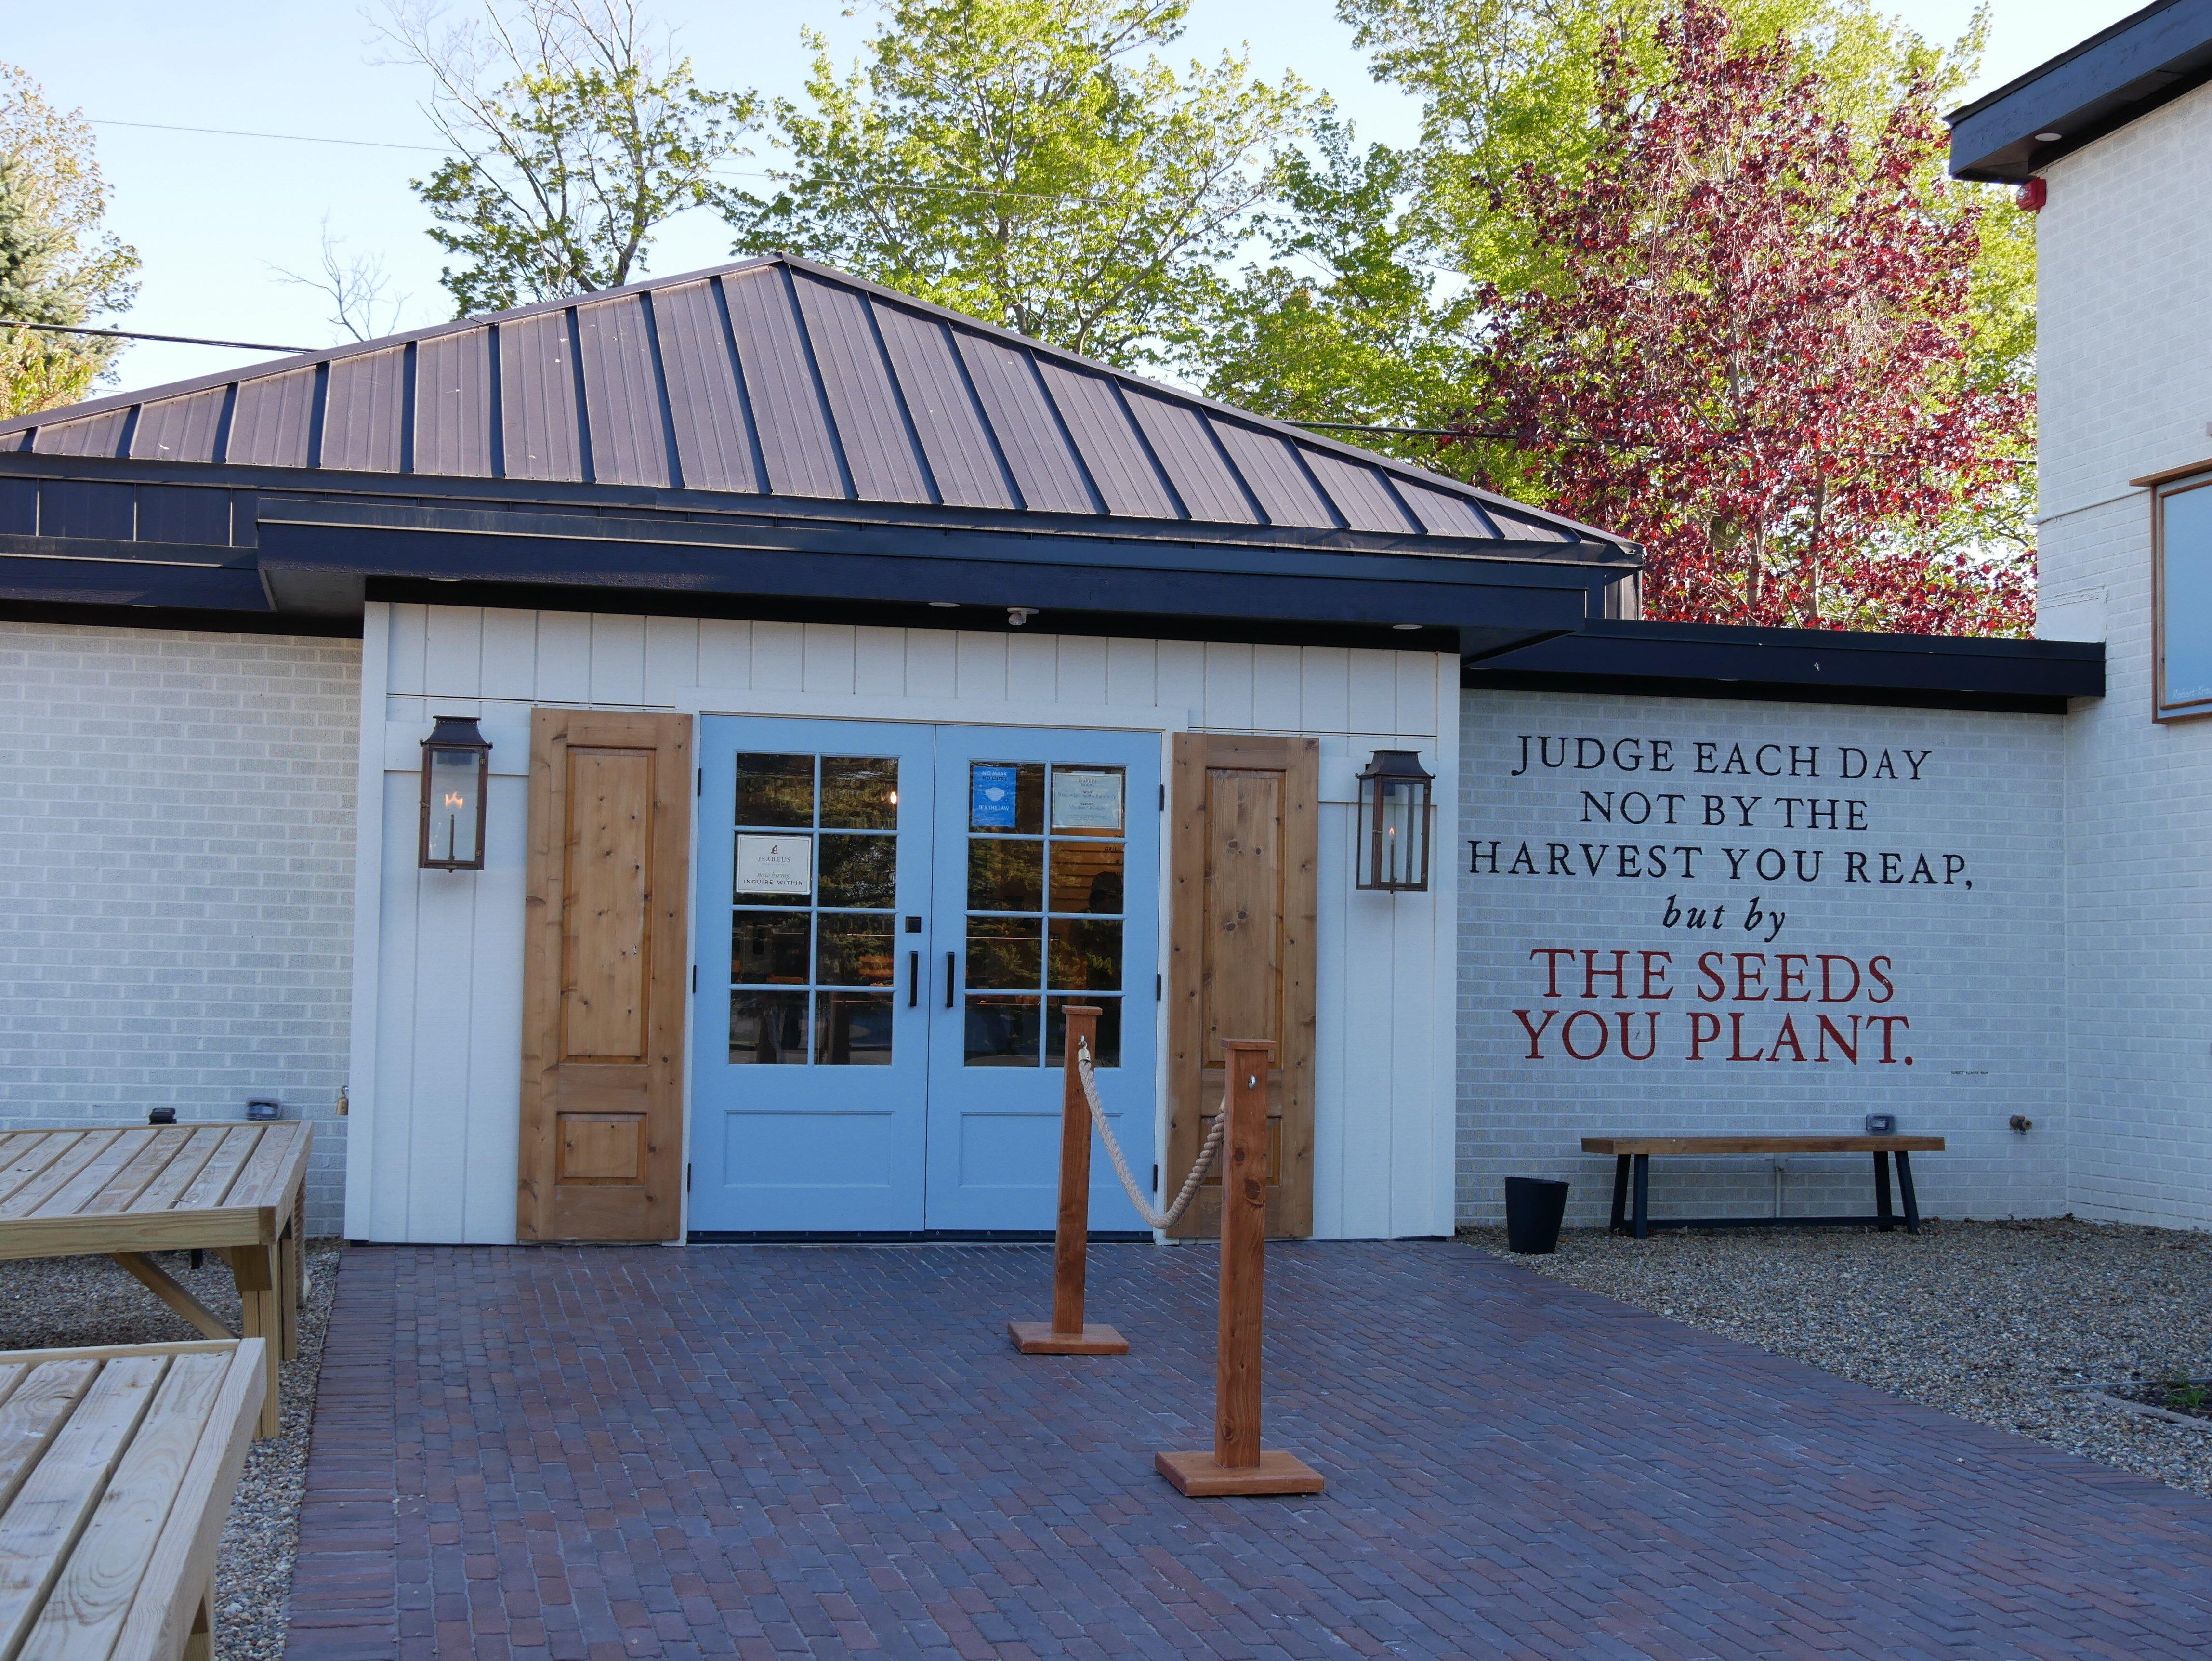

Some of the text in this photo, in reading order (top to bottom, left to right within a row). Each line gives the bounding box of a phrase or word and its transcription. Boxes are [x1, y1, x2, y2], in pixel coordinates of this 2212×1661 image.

[1511, 736, 1932, 780] JUDGE EACH DAY
[1580, 791, 1868, 830] NOT BY THE
[1467, 841, 1972, 890] HARVEST YOU REAP,
[1663, 894, 1785, 942] but by
[1529, 949, 1894, 1003] THE SEEDS
[1512, 1010, 1913, 1065] YOU PLANT.
